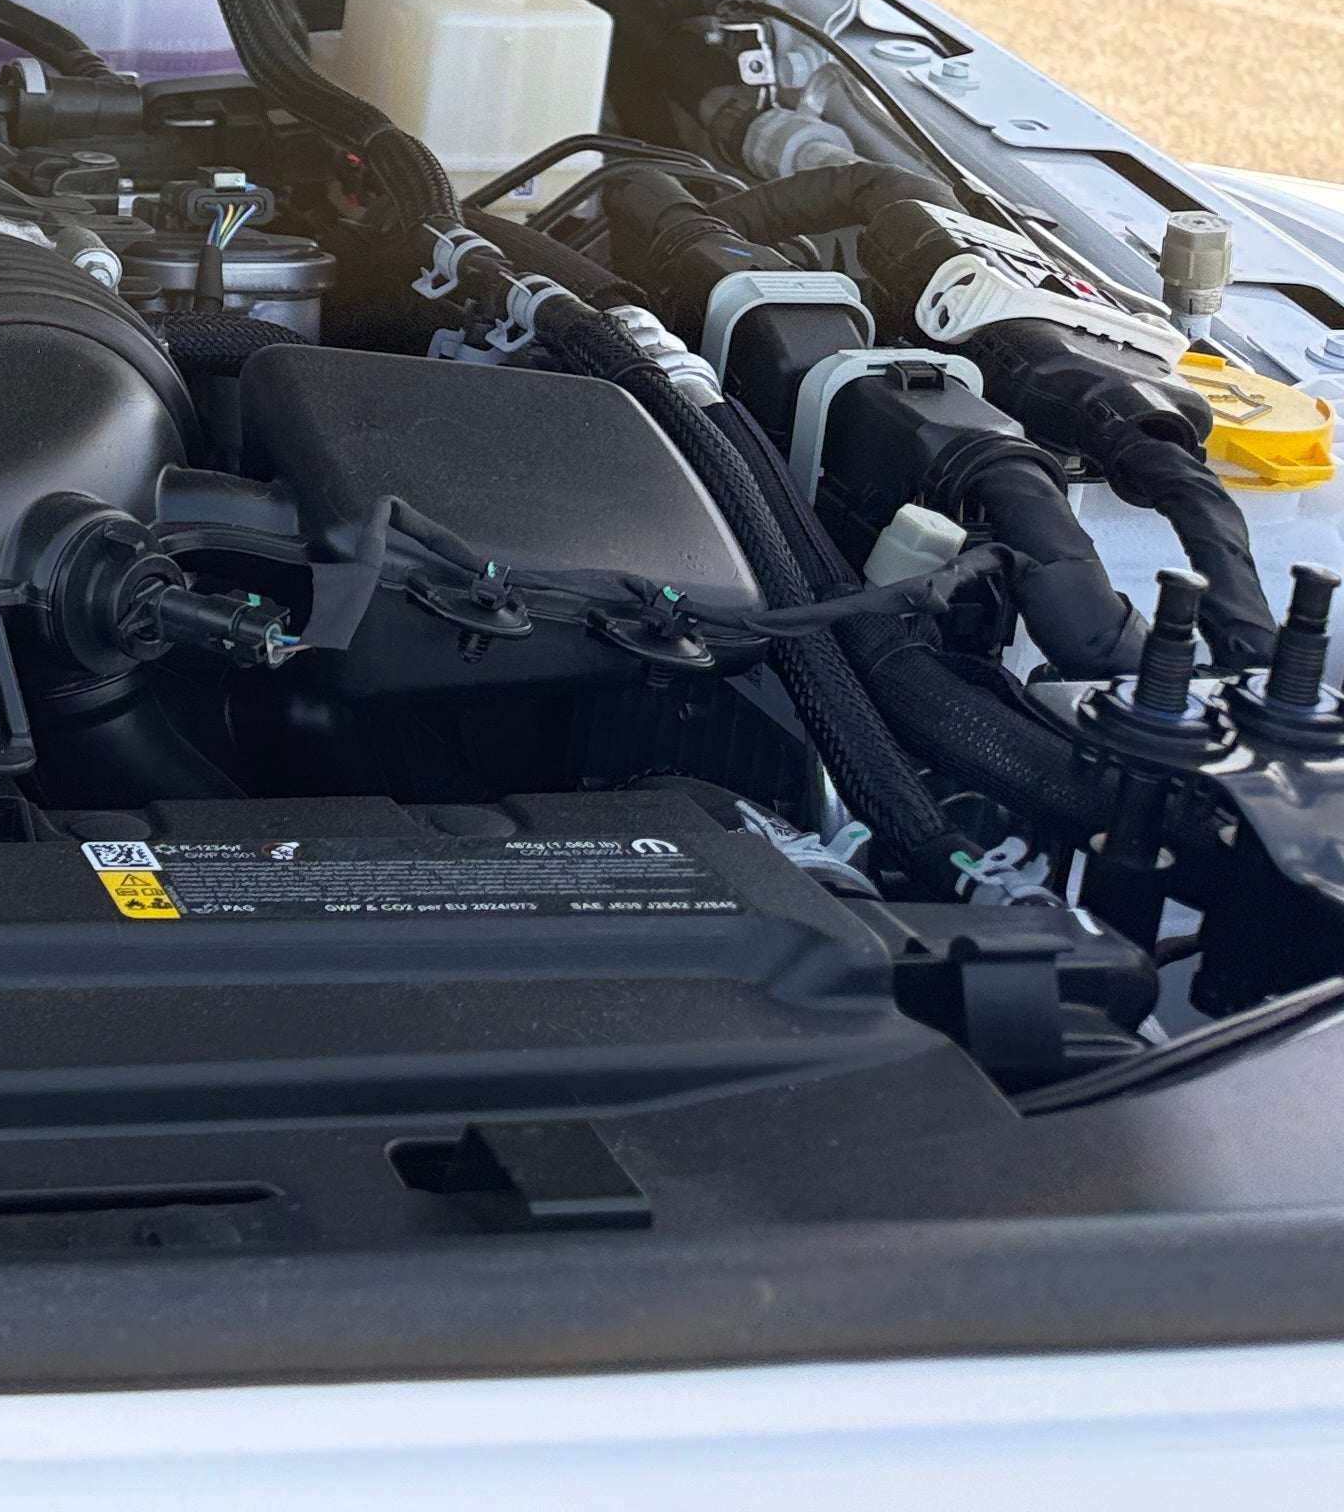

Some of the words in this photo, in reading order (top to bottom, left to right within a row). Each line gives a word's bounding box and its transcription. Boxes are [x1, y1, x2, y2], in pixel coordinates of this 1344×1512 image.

[222, 903, 256, 913] PAG
[324, 903, 362, 912] GWP
[380, 903, 414, 912] CO2
[418, 904, 441, 913] per
[444, 903, 468, 912] EU
[569, 901, 605, 911] SAE
